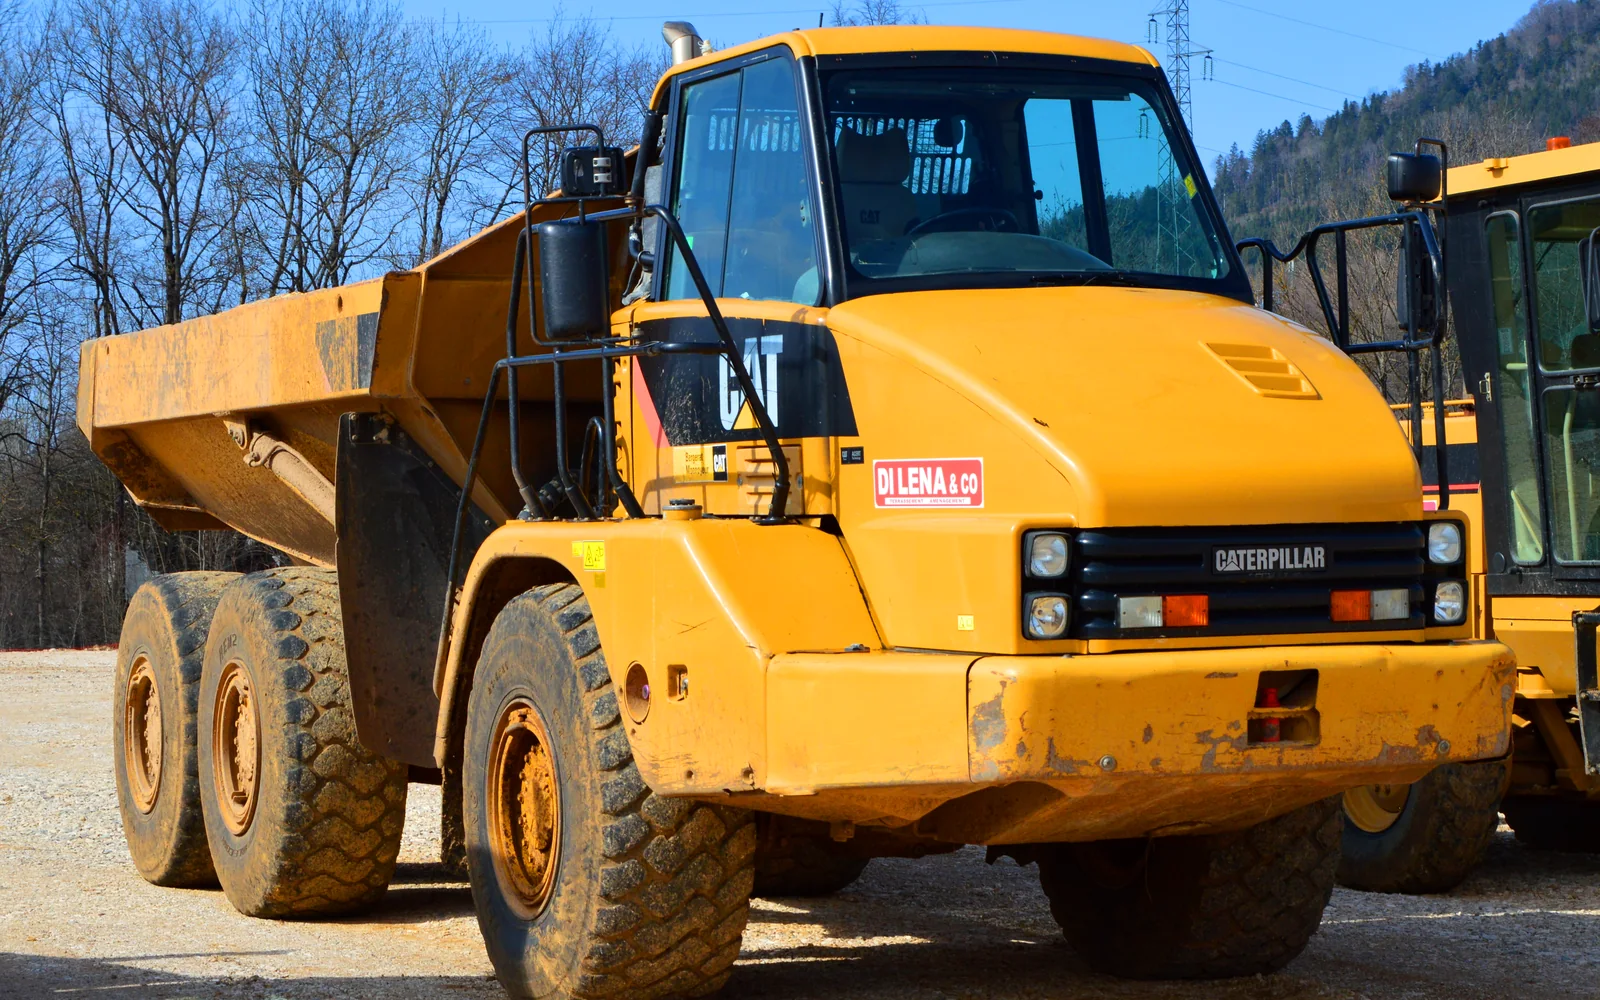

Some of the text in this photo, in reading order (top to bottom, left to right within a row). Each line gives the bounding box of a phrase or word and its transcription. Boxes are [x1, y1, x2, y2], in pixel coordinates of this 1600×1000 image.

[859, 209, 881, 224] CAT
[719, 334, 784, 430] CAT
[713, 454, 727, 473] CAT
[877, 466, 979, 495] DI LENA & CO
[1215, 546, 1325, 572] CATERPILLAR
